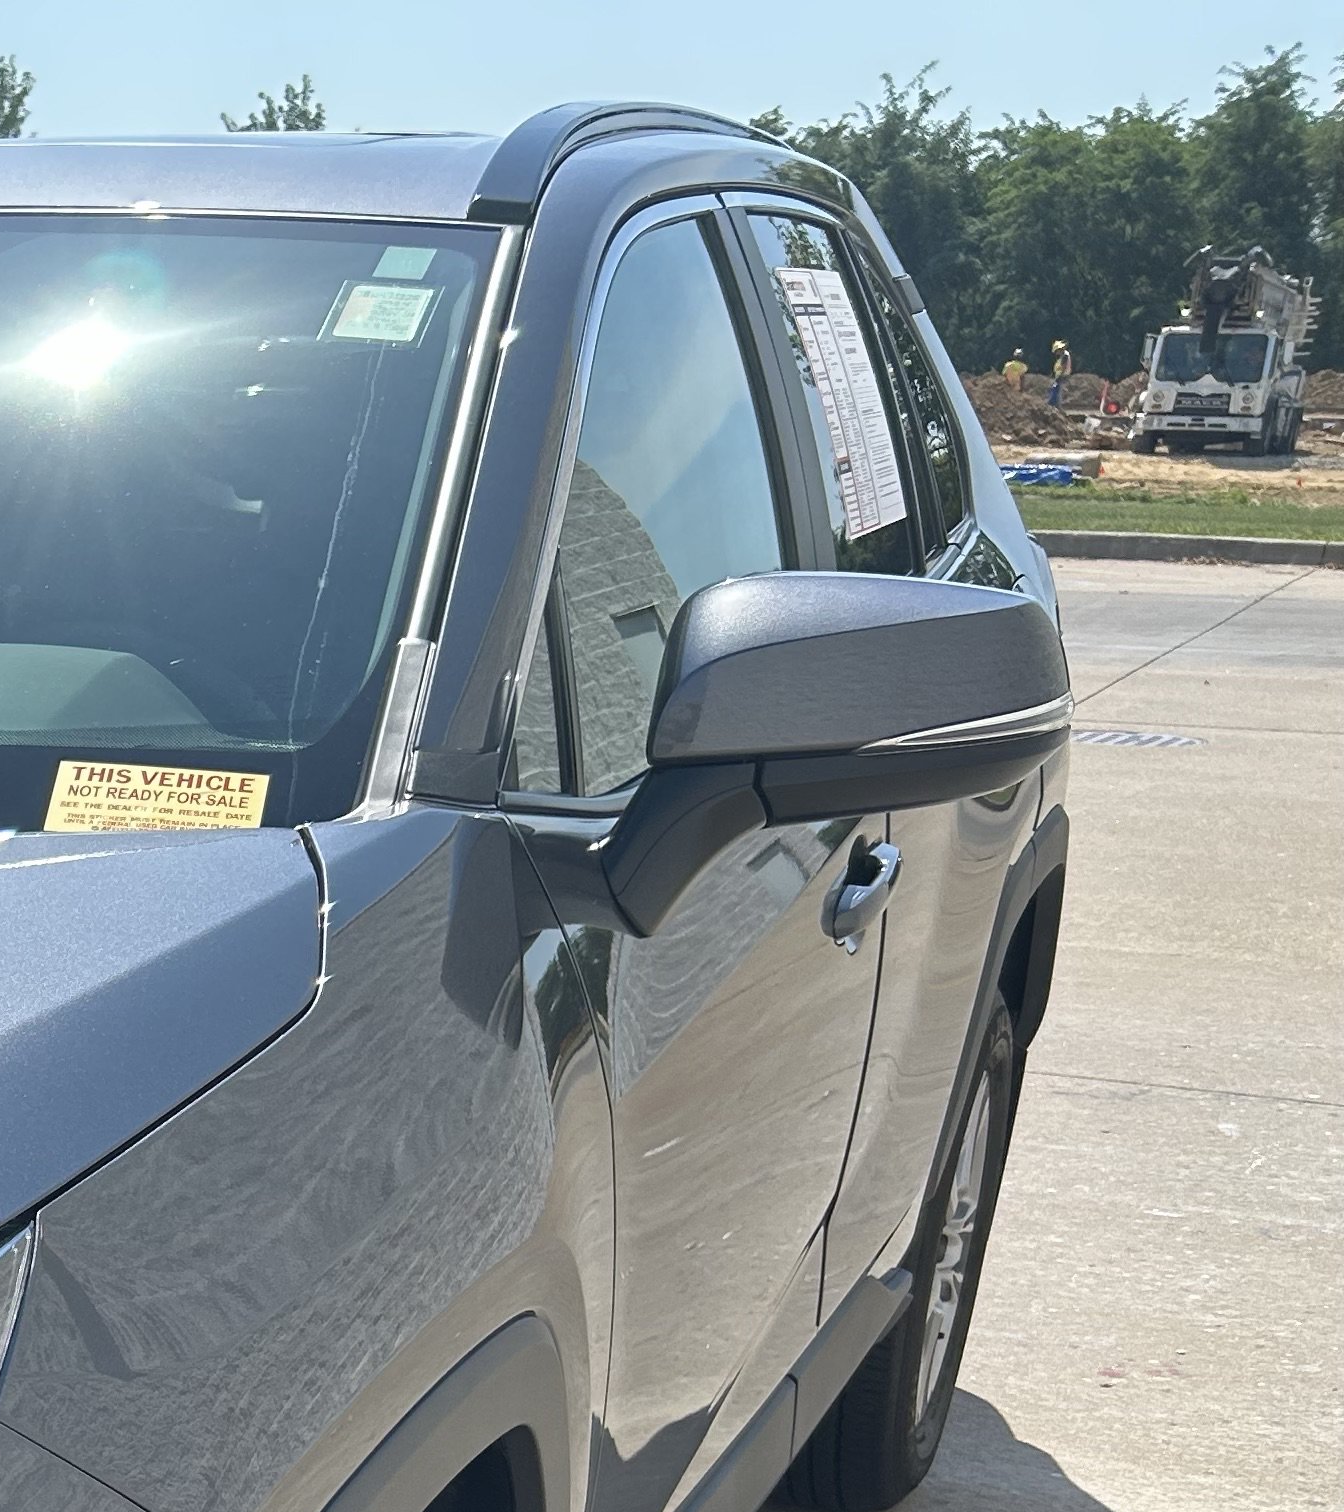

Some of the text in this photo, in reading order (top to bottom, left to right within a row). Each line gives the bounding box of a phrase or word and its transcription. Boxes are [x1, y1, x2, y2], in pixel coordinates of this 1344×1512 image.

[72, 766, 256, 794] THIS VEHICLE
[67, 784, 250, 810] NOT READY FOR SALE
[60, 800, 80, 808] SEE
[84, 802, 104, 810] THE
[178, 808, 221, 819] RESALE
[225, 812, 253, 821] DATE
